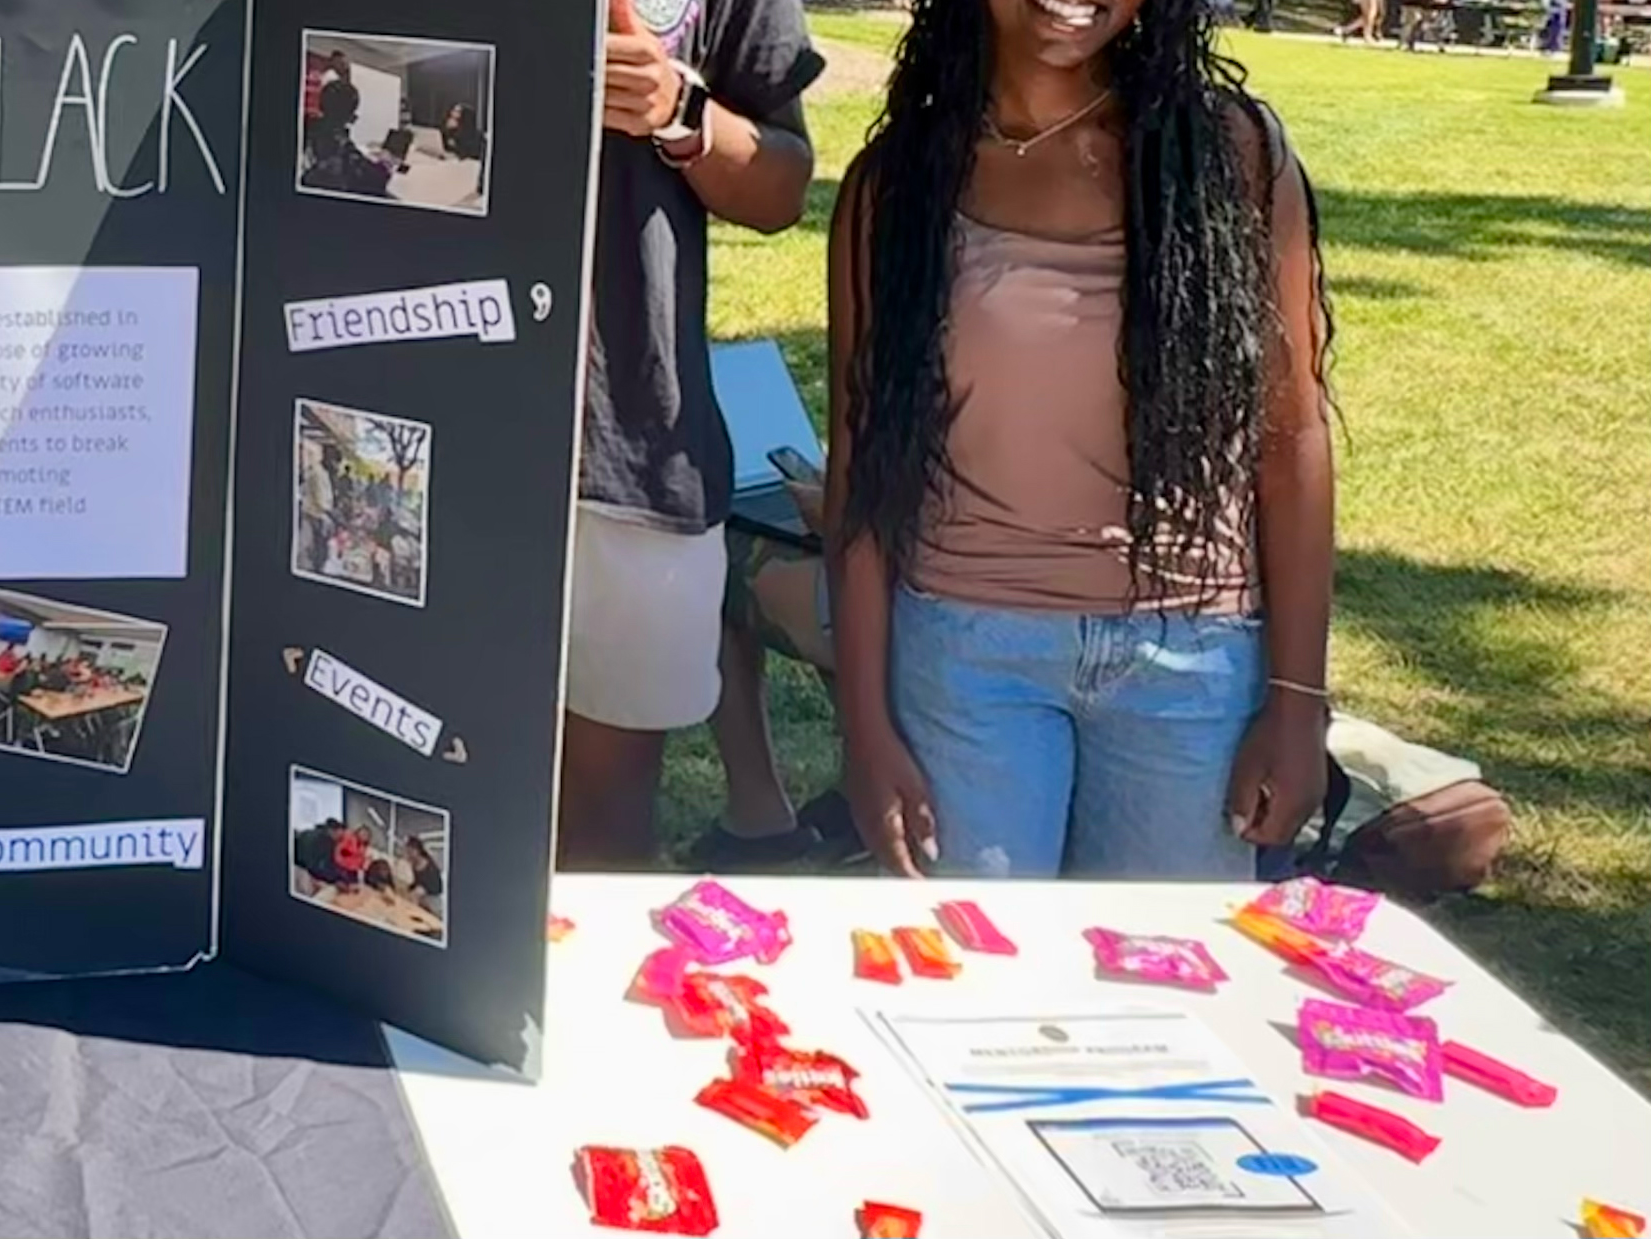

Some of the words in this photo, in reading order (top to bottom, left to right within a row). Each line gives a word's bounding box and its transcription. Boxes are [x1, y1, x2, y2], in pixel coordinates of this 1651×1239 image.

[118, 309, 139, 326] in
[289, 290, 502, 343] Friendship
[31, 341, 51, 359] of
[57, 342, 145, 363] growing
[26, 371, 47, 391] of
[52, 371, 145, 391] software
[28, 403, 152, 423] enthusiasts,
[45, 436, 67, 452] to
[72, 434, 130, 453] break
[309, 654, 433, 752] Events
